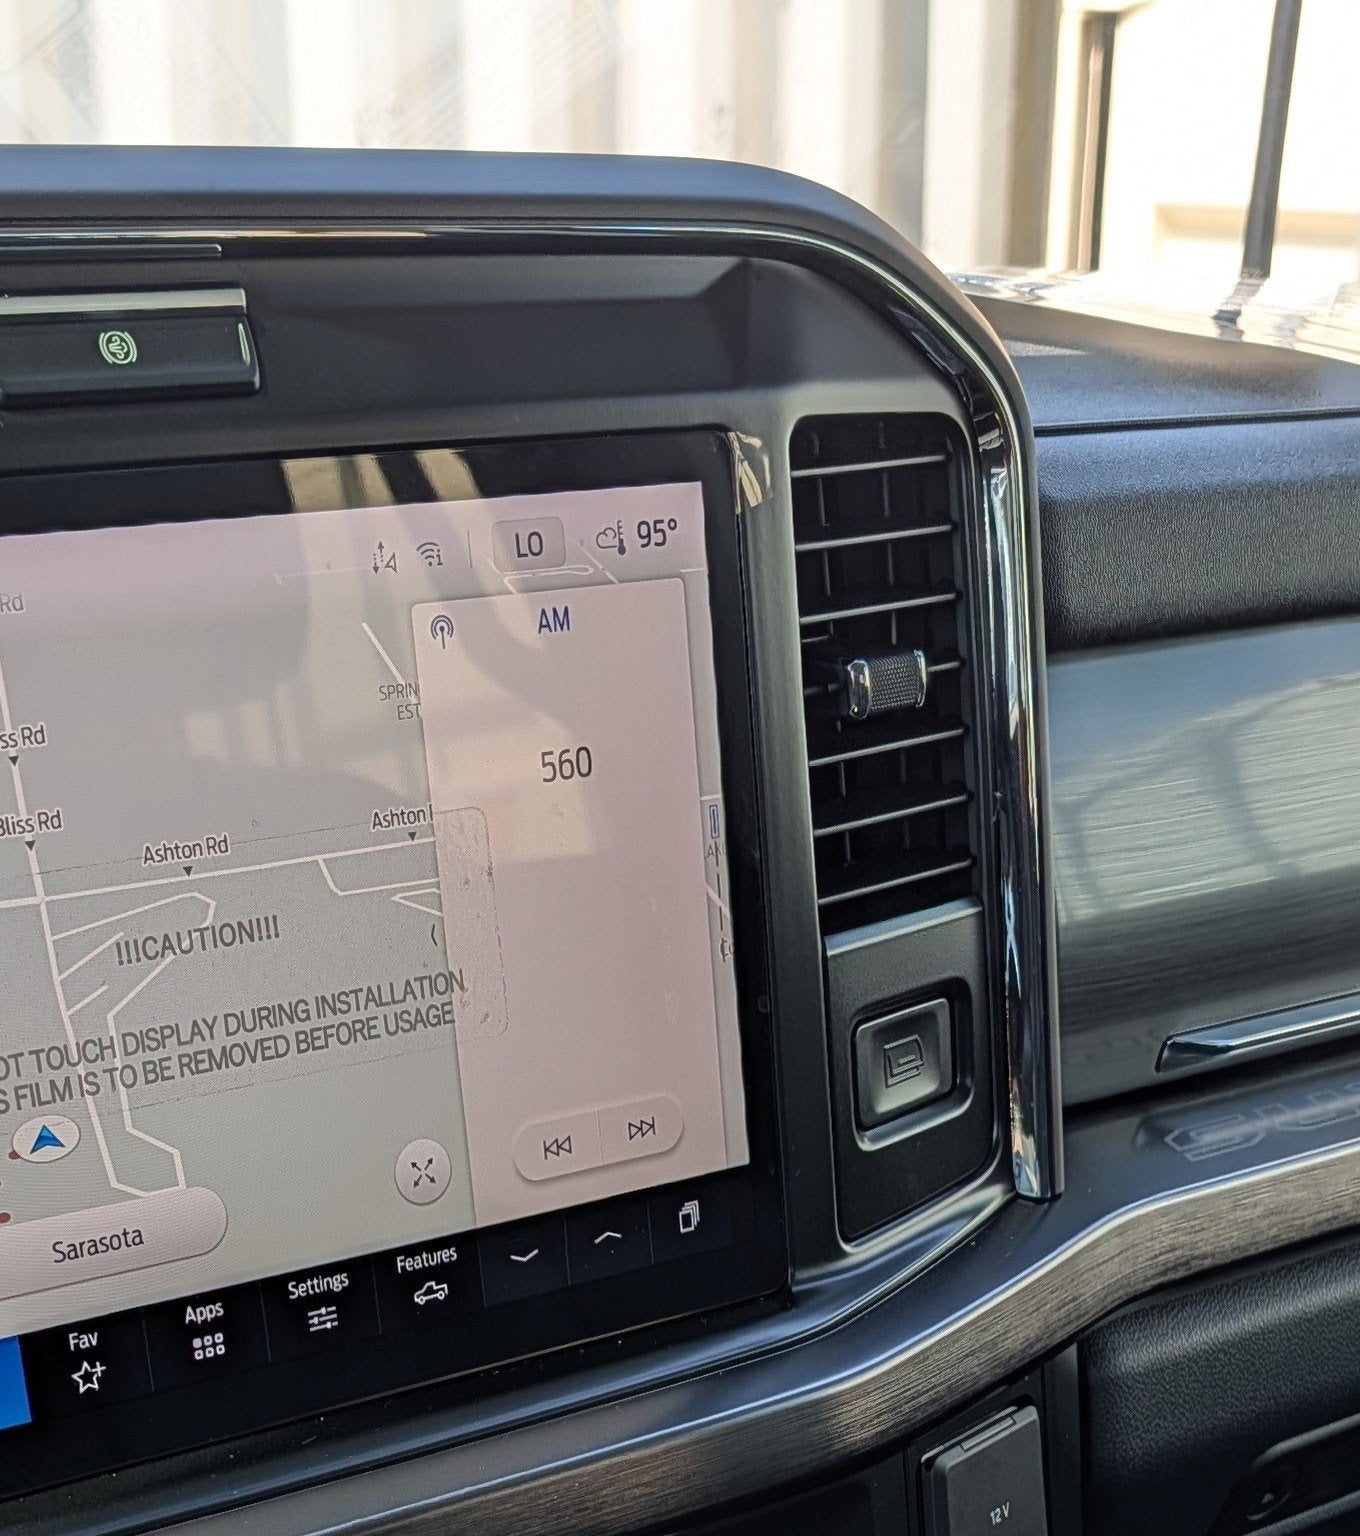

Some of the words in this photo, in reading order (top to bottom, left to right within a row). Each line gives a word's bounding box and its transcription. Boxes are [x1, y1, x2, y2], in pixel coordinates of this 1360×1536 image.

[514, 531, 544, 559] LO
[637, 518, 678, 549] 95°
[0, 593, 24, 613] Rd
[538, 606, 571, 634] AM
[378, 681, 420, 701] SPRIN
[20, 724, 46, 747] Rd
[541, 745, 593, 783] 560
[37, 809, 64, 831] Rd
[372, 808, 426, 830] Ashton
[142, 839, 201, 866] Ashton
[204, 835, 229, 858] Rd
[114, 914, 281, 967] !!!CAUTION!!!
[27, 1038, 118, 1081] TOUCH
[121, 1016, 220, 1061] DISPLAY
[223, 1000, 312, 1039] DURING
[314, 968, 467, 1022] INSTALLATION
[13, 1079, 74, 1112] FILM
[78, 1070, 100, 1099] IS
[103, 1062, 138, 1094] TO
[141, 1054, 176, 1086] BE
[177, 1029, 294, 1079] REMOVED
[295, 1011, 382, 1055] BEFORE
[383, 1000, 456, 1040] USAGE
[52, 1226, 145, 1265] Sarasota
[396, 1244, 458, 1275] Features
[288, 1270, 350, 1302] Settings
[185, 1300, 225, 1328] Apps
[68, 1329, 100, 1352] Fav
[989, 1501, 1011, 1527] 12V
